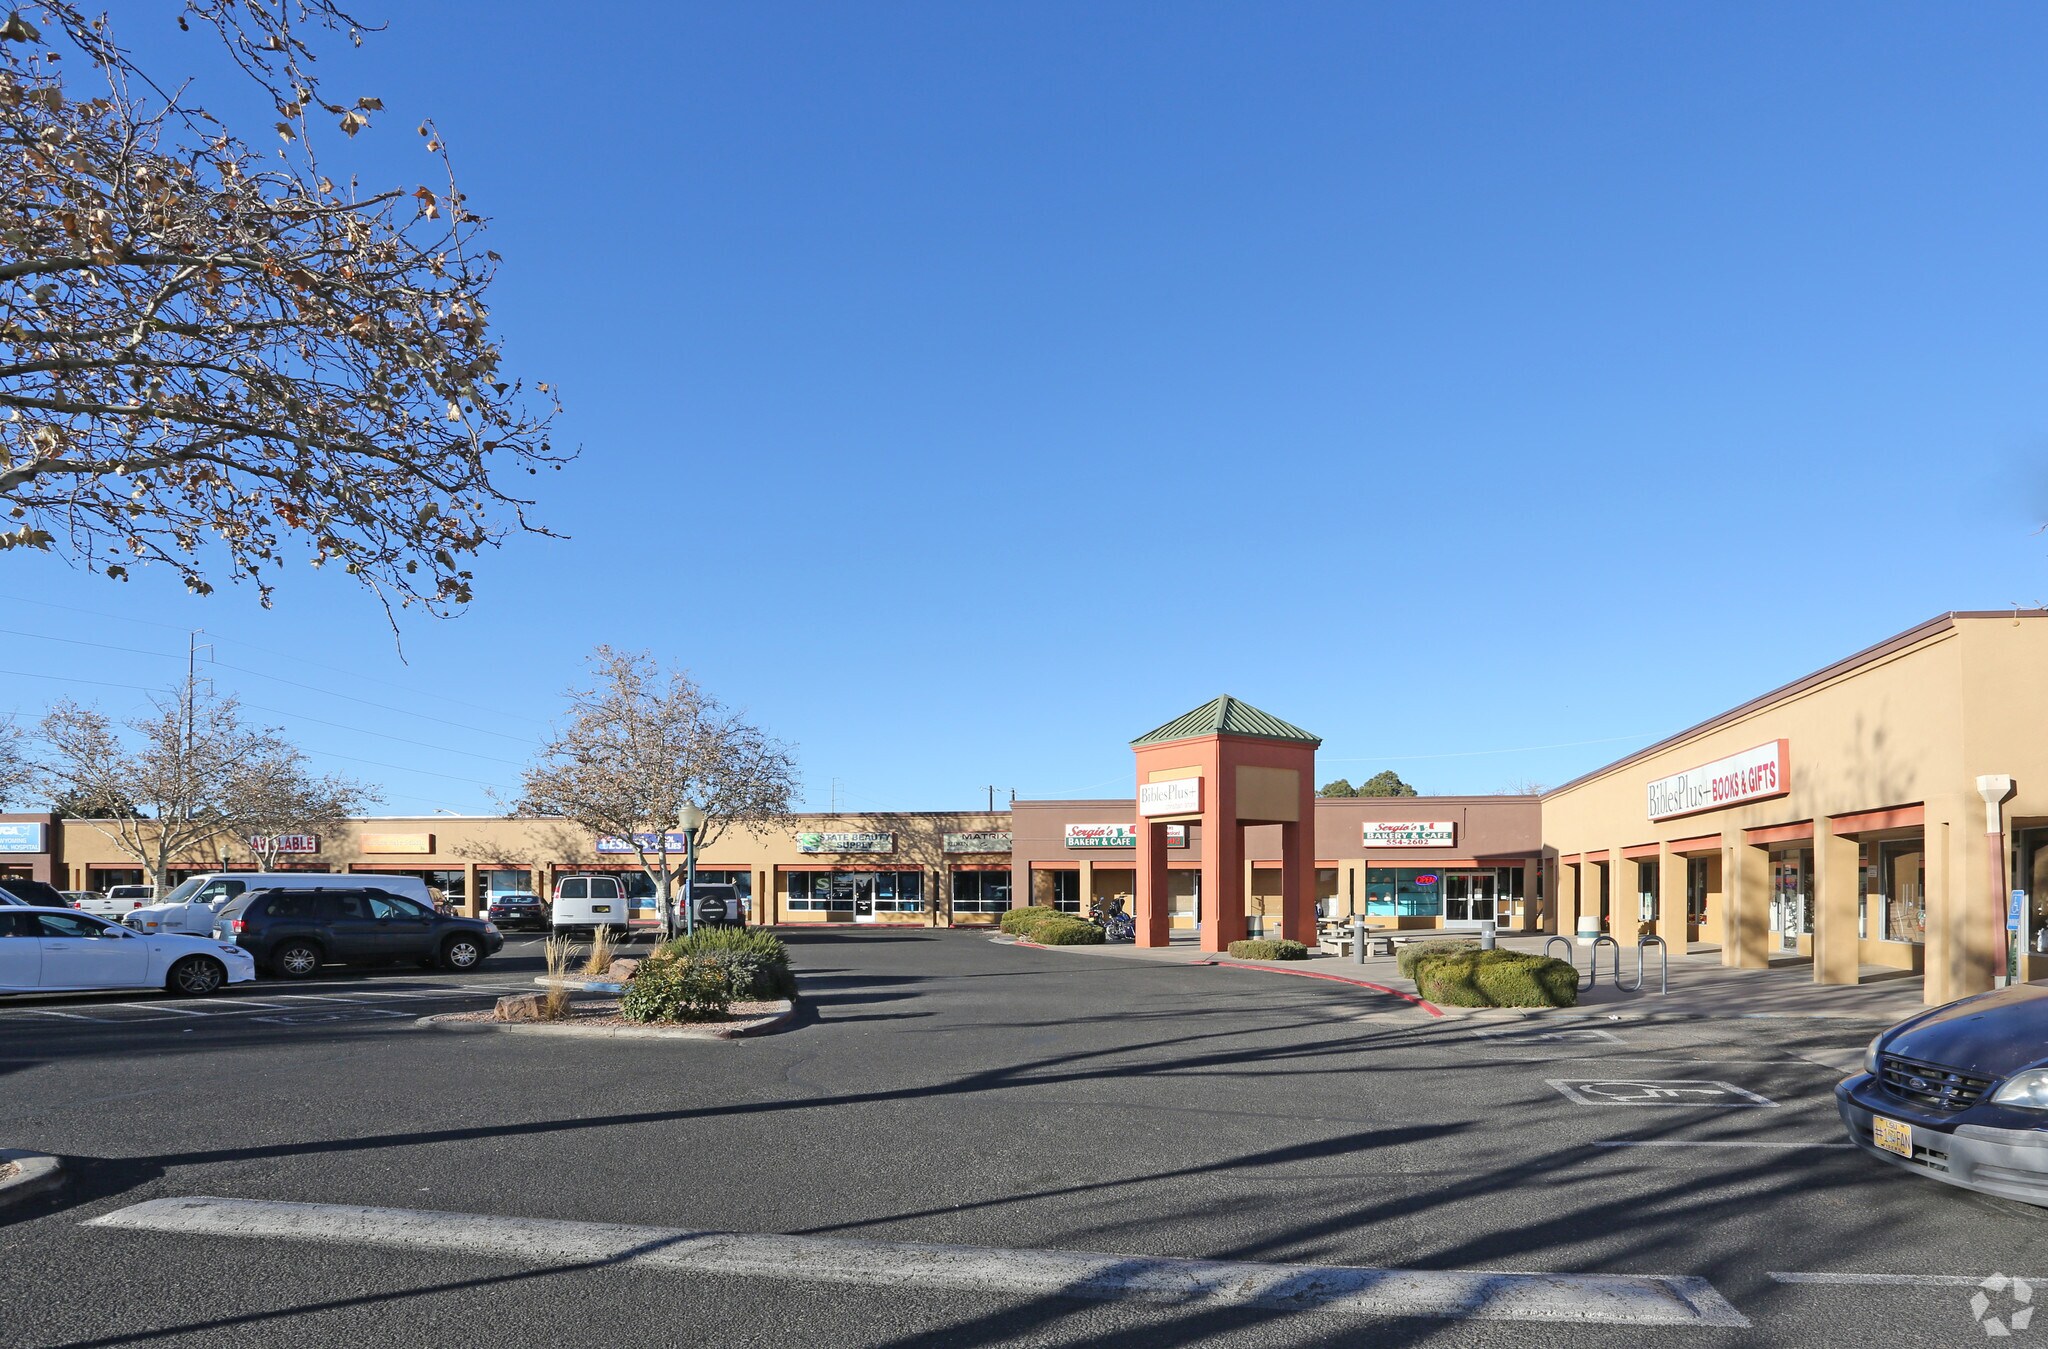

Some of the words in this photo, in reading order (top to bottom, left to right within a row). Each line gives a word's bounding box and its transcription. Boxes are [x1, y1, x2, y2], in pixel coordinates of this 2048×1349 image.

[1712, 772, 1739, 801] BOOKS
[1741, 770, 1747, 795] &
[1748, 761, 1776, 793] GIFTS
[1068, 826, 1113, 838] Sergio's
[1375, 823, 1417, 833] Sergio's
[1068, 838, 1099, 846] BAKERY
[1101, 838, 1108, 846] &
[1110, 838, 1131, 846] CAFE
[1896, 1131, 1910, 1149] FAN
